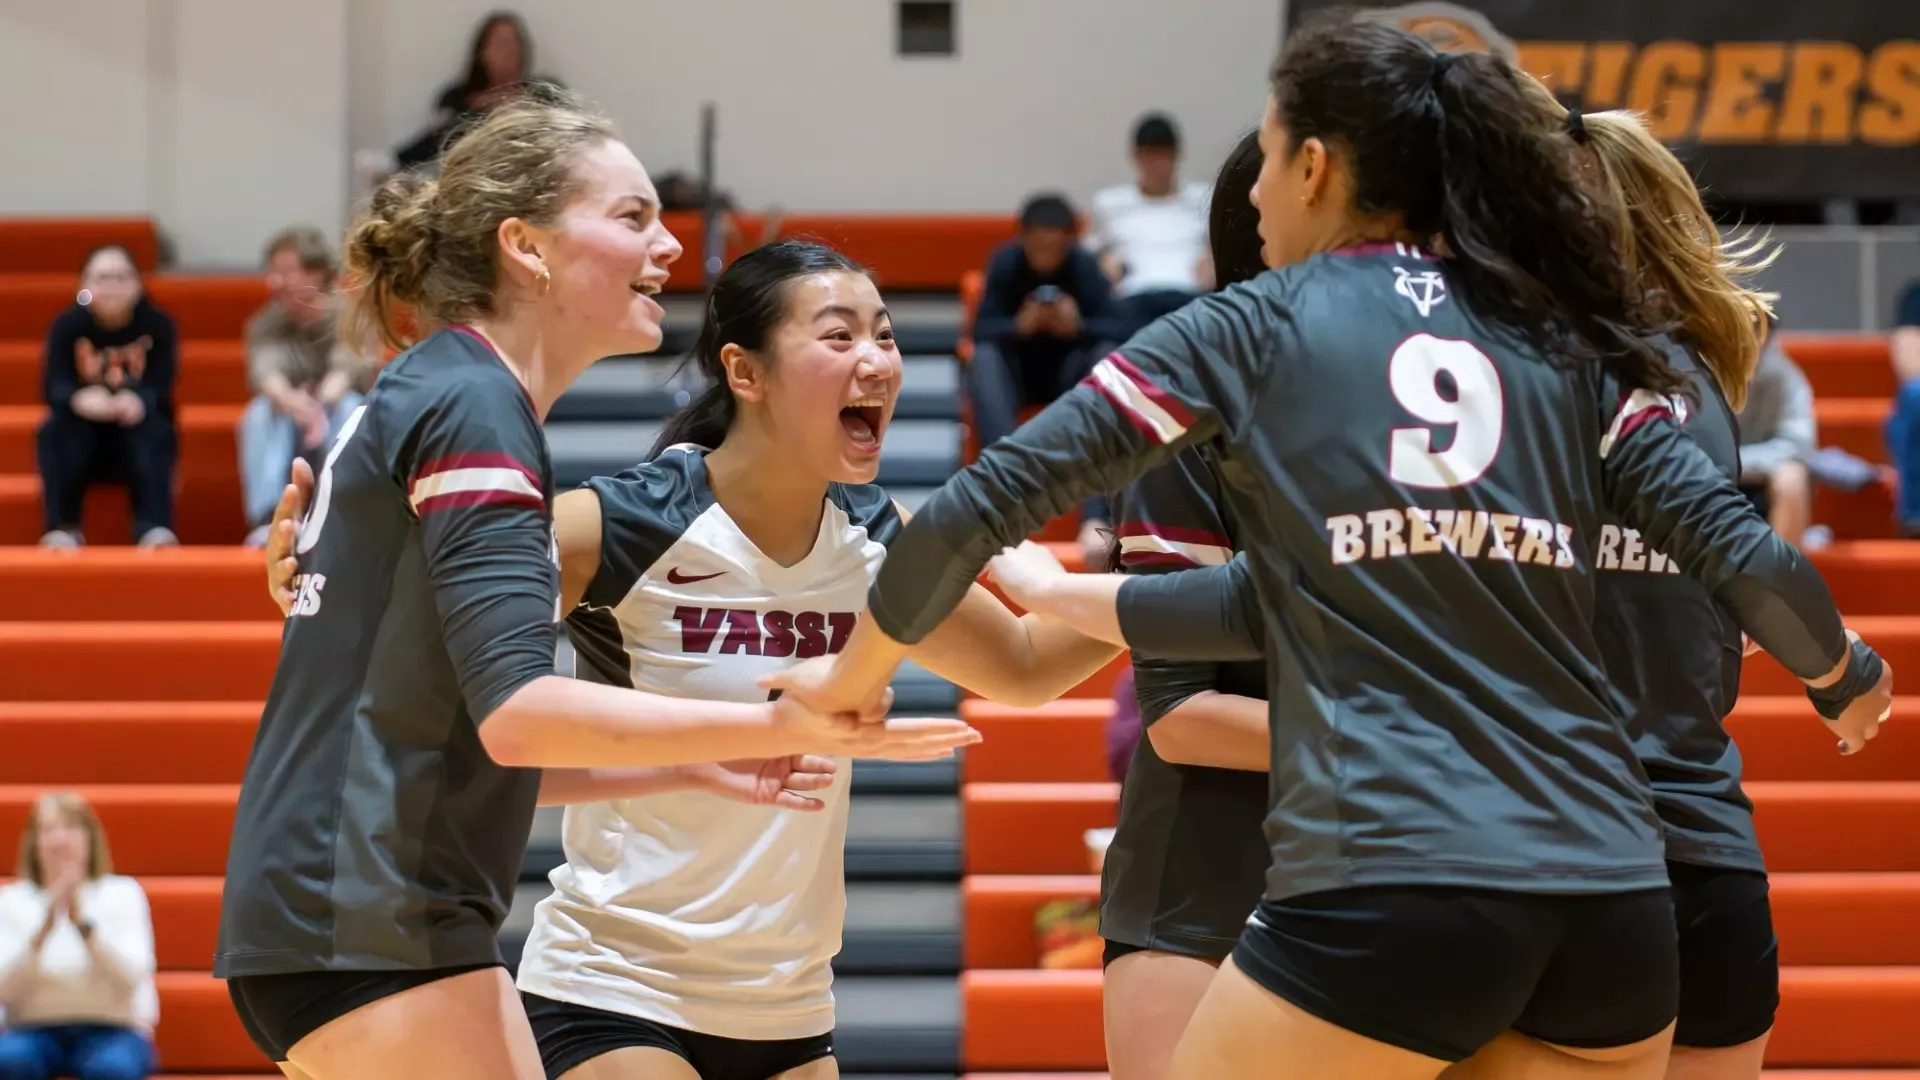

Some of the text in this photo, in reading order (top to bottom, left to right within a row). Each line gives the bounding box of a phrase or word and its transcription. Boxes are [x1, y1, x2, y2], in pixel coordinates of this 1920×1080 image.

[1388, 331, 1504, 490] 9
[1325, 505, 1576, 570] BREWERS
[672, 605, 861, 660] VASSA
